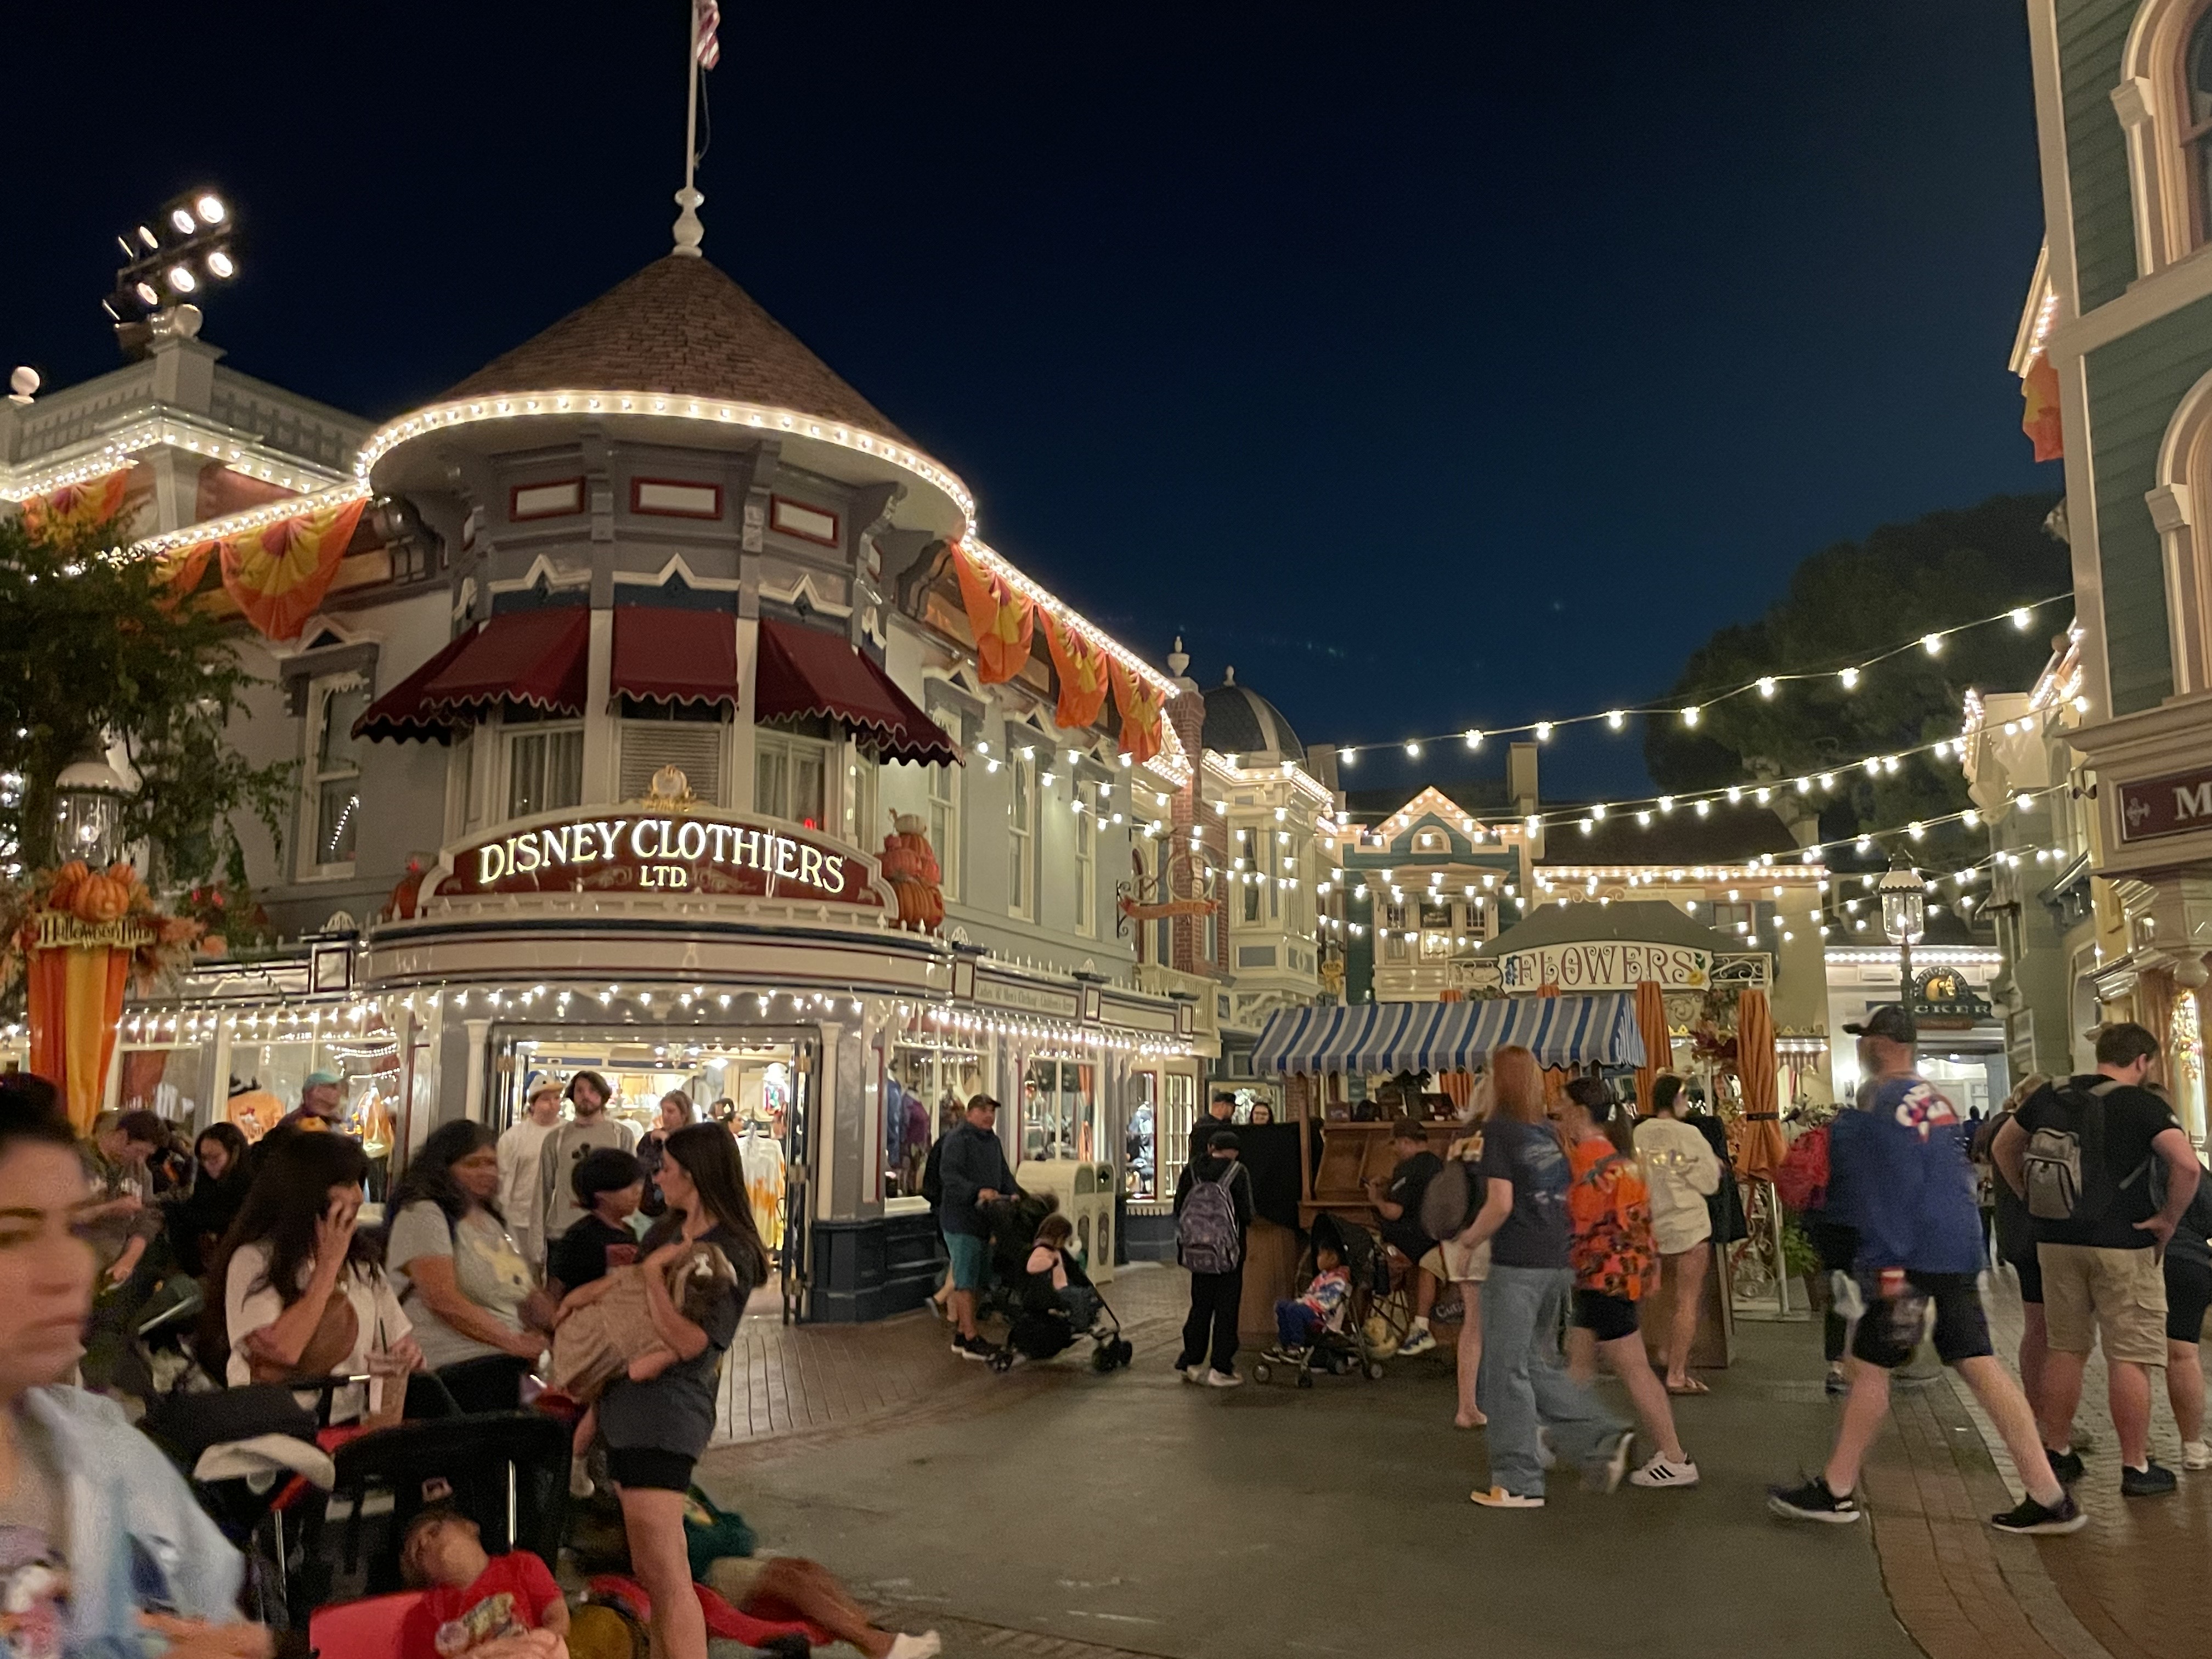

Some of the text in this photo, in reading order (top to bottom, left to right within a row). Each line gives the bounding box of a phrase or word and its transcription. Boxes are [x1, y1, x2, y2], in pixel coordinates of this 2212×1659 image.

[479, 819, 845, 893] DISNEY CLOTHIERS
[640, 865, 687, 887] LTD.
[1517, 945, 1694, 986] FLOWERS
